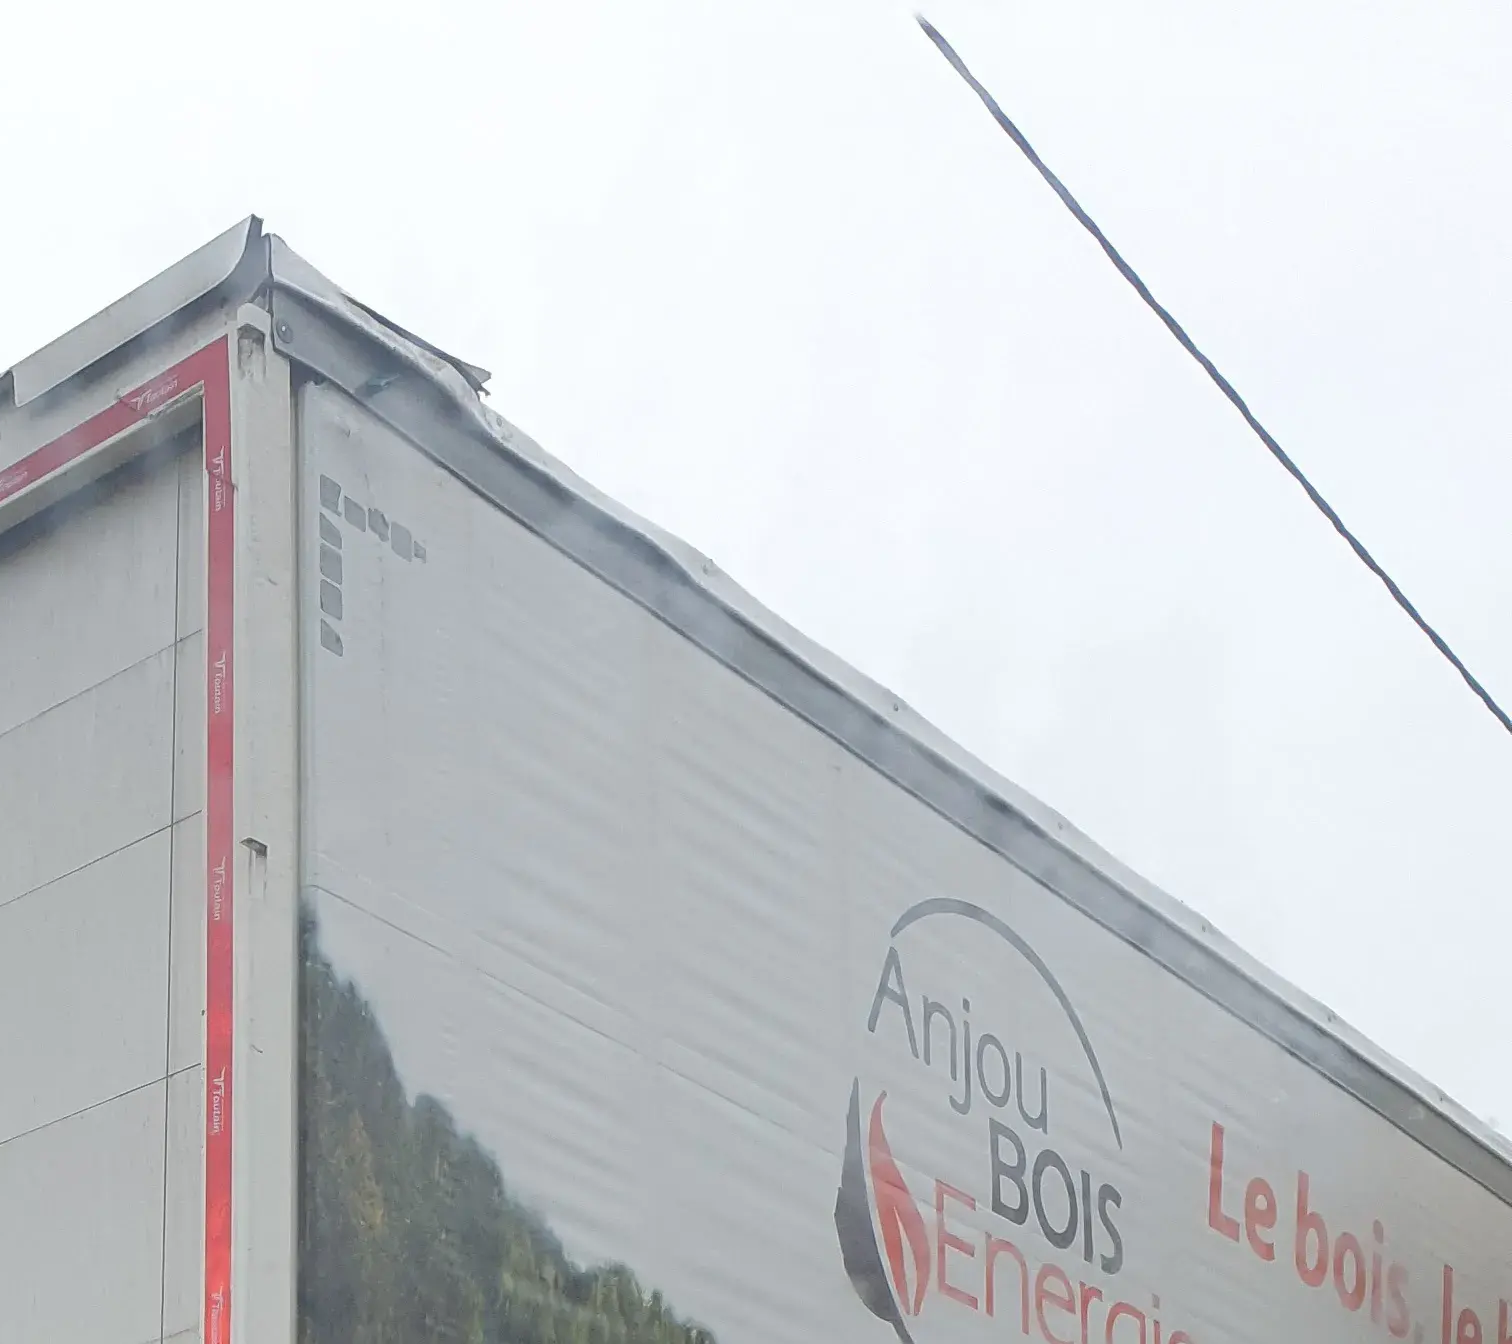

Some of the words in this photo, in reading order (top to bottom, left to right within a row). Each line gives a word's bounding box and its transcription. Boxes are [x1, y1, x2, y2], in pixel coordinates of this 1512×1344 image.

[868, 945, 1048, 1135] Anjou
[988, 1117, 1124, 1276] BOIS
[1208, 1120, 1278, 1262] Le
